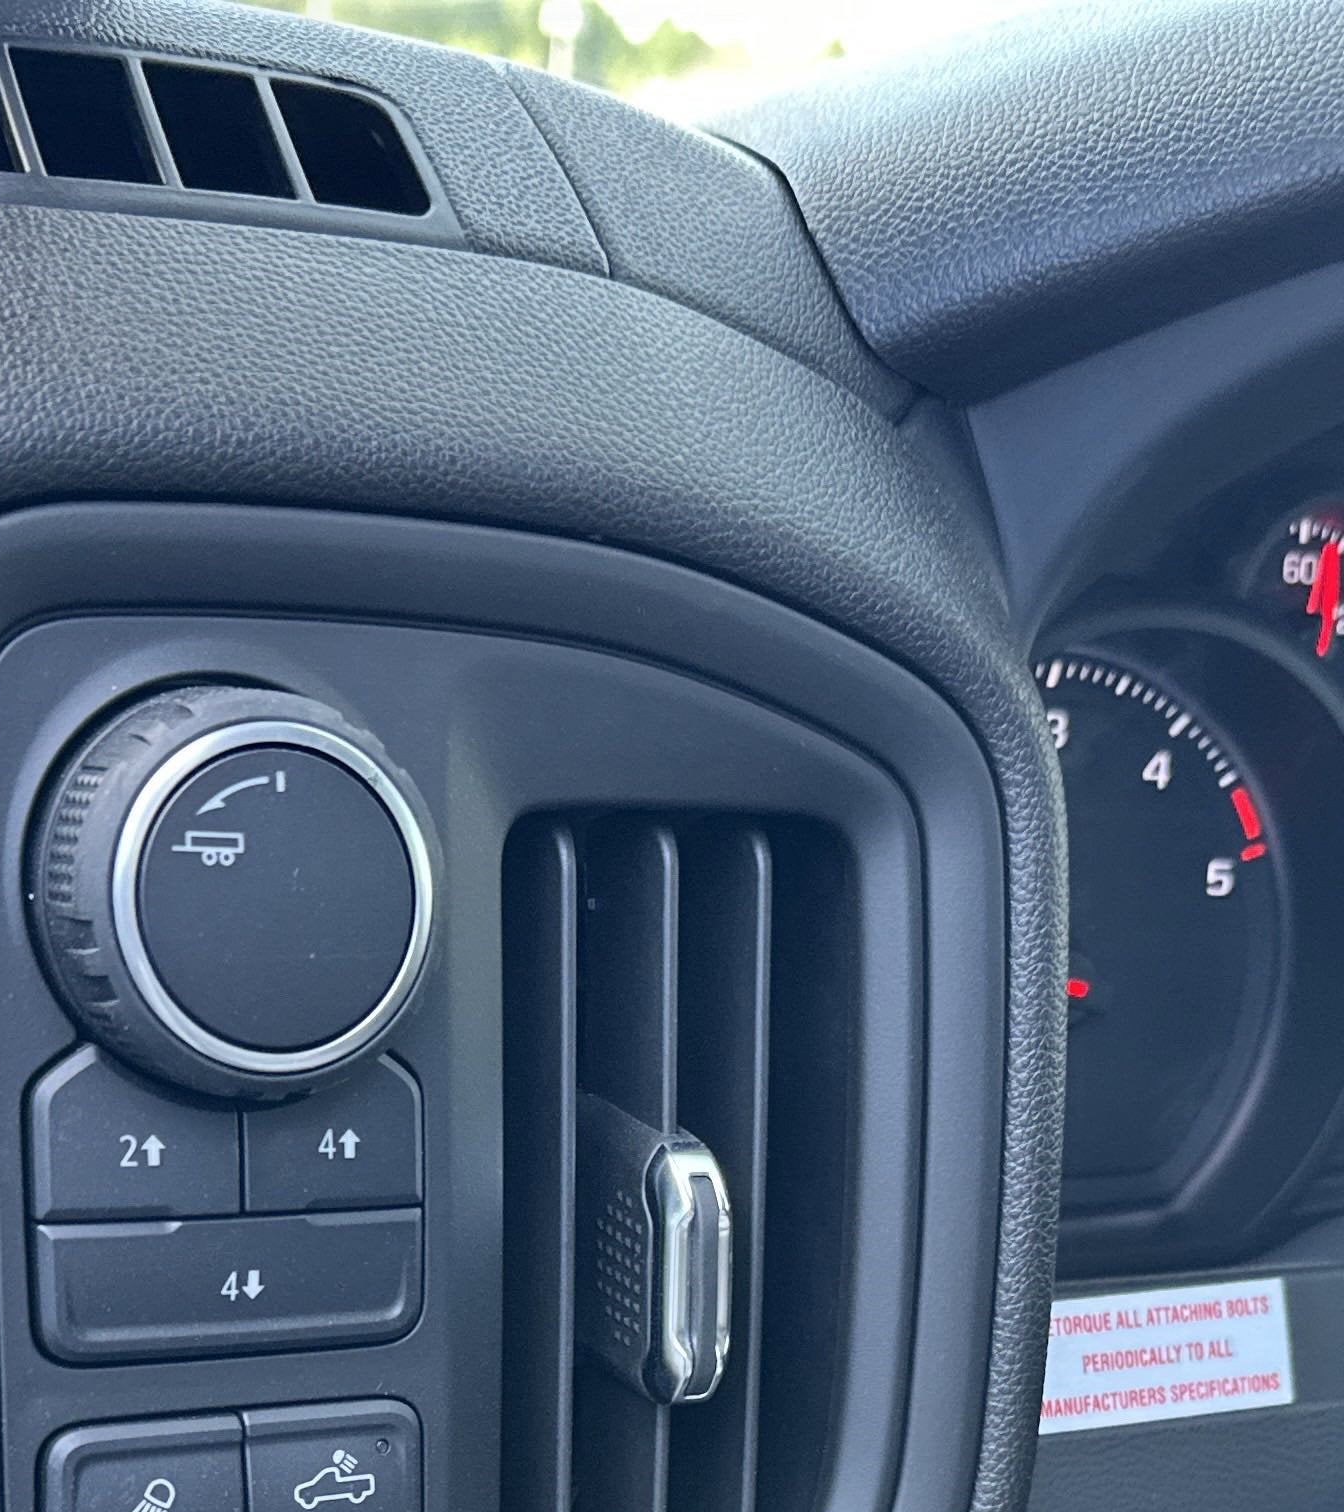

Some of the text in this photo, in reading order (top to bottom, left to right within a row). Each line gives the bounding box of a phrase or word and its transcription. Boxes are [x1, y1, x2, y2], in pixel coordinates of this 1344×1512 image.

[1282, 551, 1319, 585] 60
[1047, 711, 1069, 749] 3
[1142, 750, 1173, 790] 4
[1206, 857, 1236, 897] 5
[1116, 1310, 1143, 1330] ALL
[1146, 1301, 1223, 1327] ATTACHING
[1226, 1295, 1269, 1316] BOLTS
[1082, 1339, 1233, 1374] PERIODICALLY TO ALL
[1039, 1372, 1280, 1419] MANUFACTURERS SPECIFICATIONS
